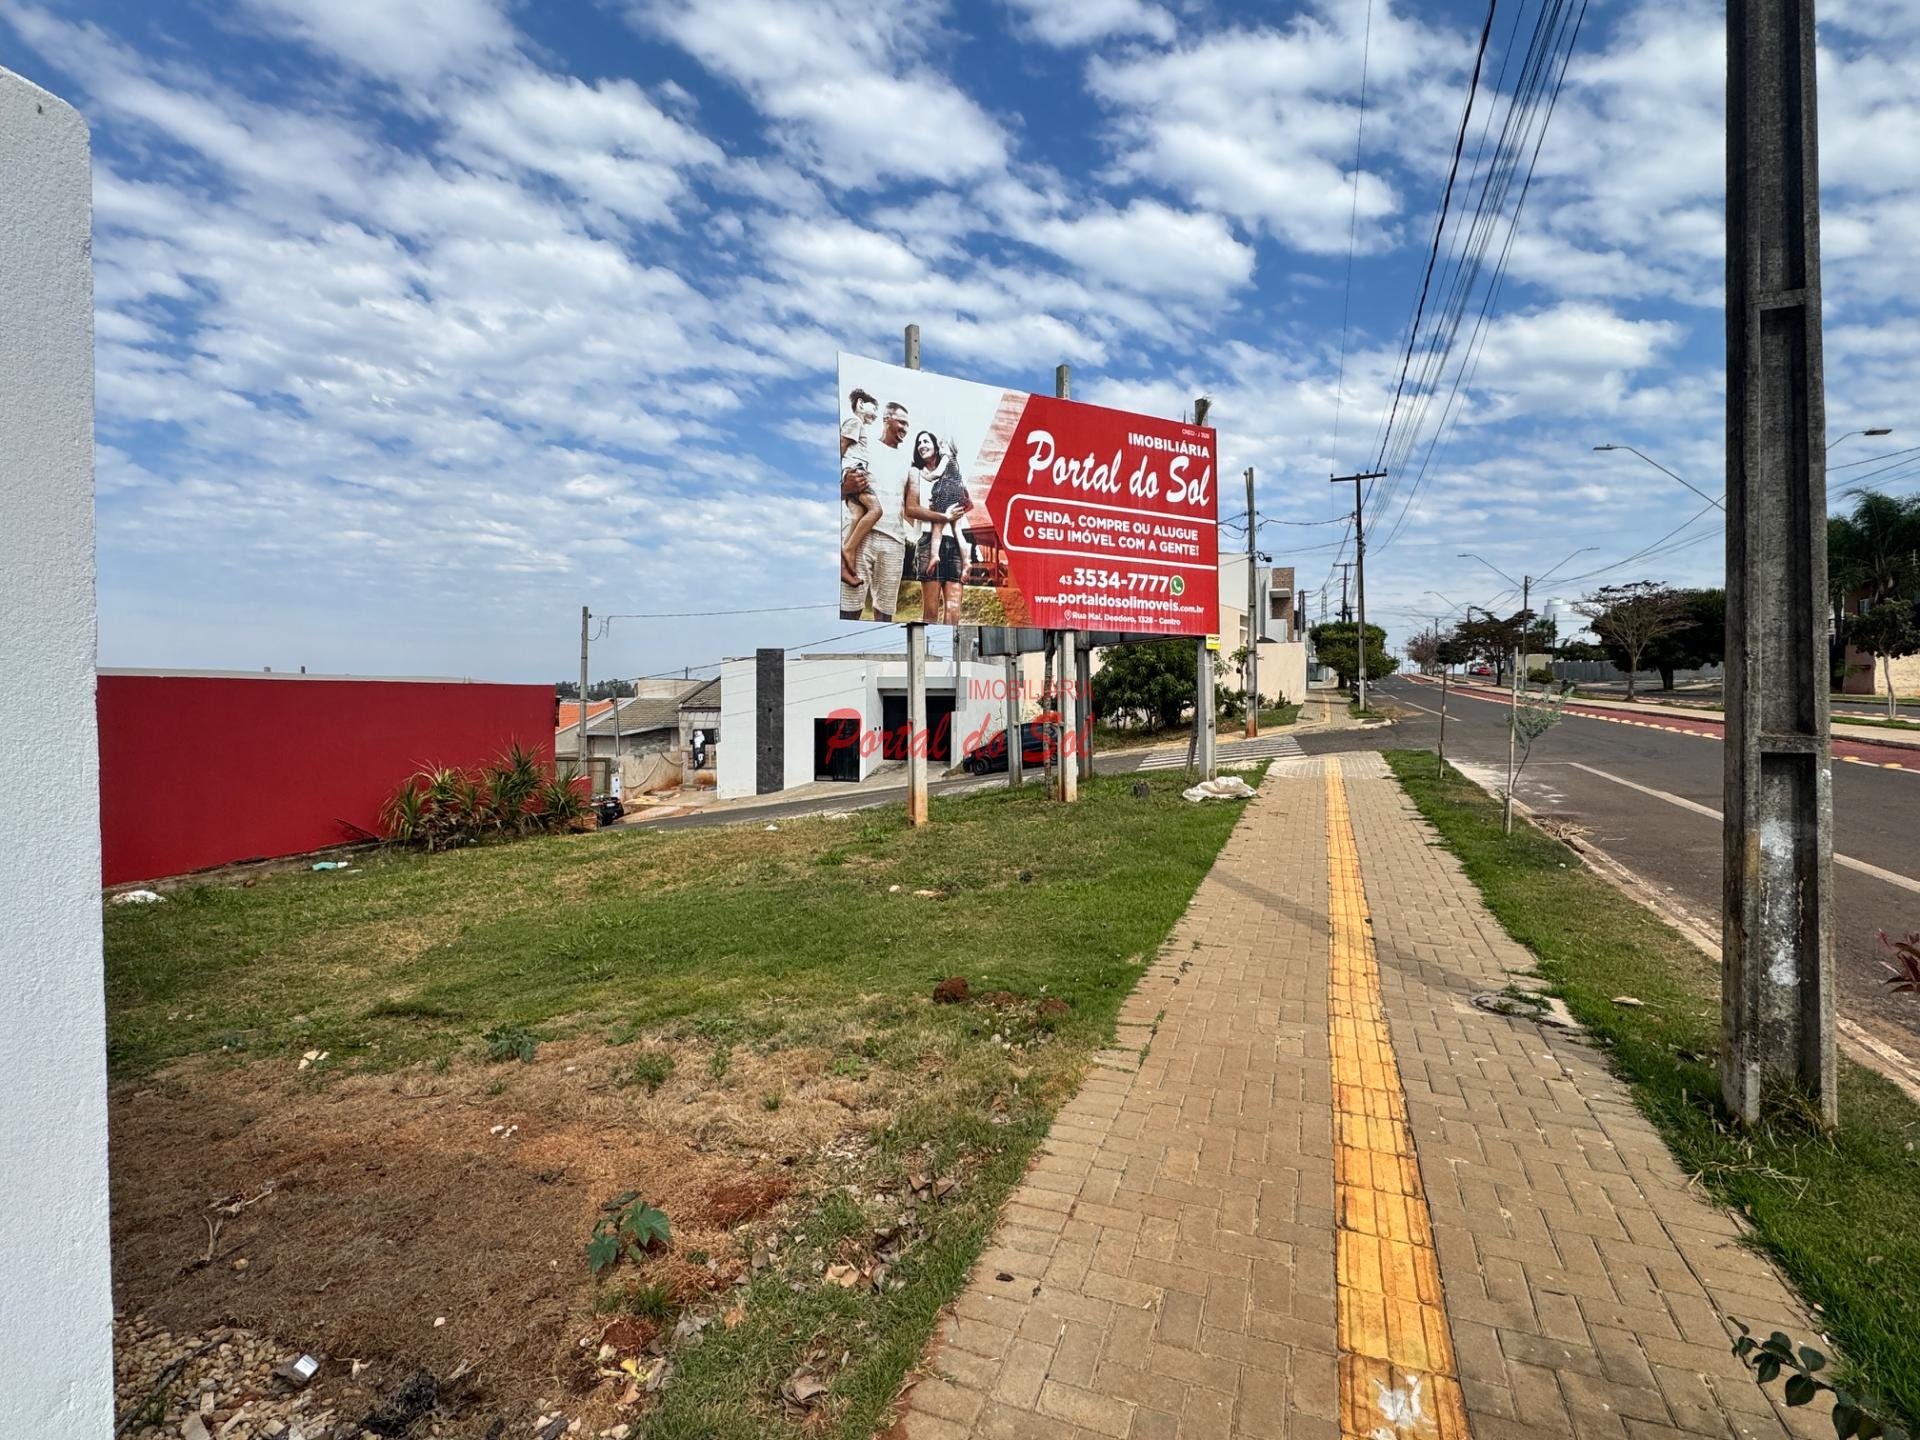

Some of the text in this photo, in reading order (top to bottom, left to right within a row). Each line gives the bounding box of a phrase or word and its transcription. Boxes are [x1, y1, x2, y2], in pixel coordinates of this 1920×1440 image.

[1128, 432, 1210, 458] IMOBILIÁRIA
[1026, 429, 1211, 507] Portal do Sol
[1024, 508, 1199, 541] VENDA, COMPRE OU ALUGUE
[1023, 526, 1199, 557] O SEU IMÓVEL COM A GENTE!
[1059, 568, 1169, 593] 43 3534-7777
[1034, 593, 1205, 614] www.portaldosolimoveis.com.br
[1072, 611, 1087, 620] Rua
[1158, 617, 1181, 626] Centro
